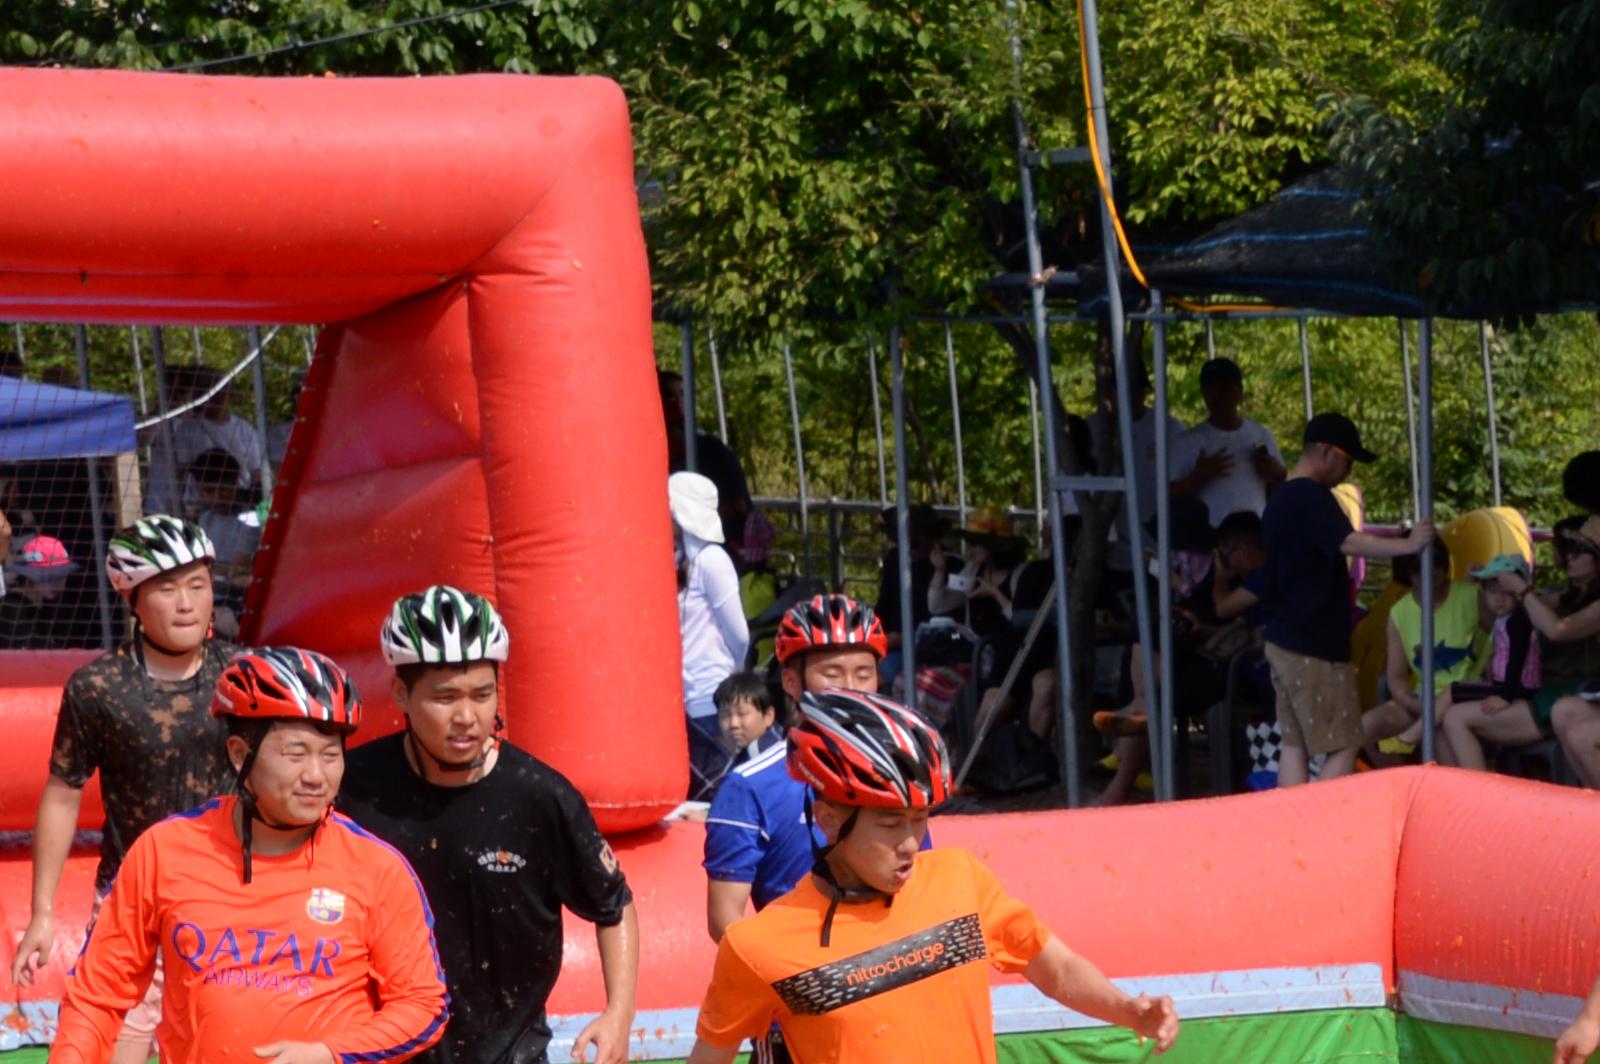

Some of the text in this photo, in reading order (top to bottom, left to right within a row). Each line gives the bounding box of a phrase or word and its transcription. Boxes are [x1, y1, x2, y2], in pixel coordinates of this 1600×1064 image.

[172, 922, 342, 977] QATAR
[846, 942, 945, 986] nitrocharge
[203, 967, 313, 996] AIRWAYS
